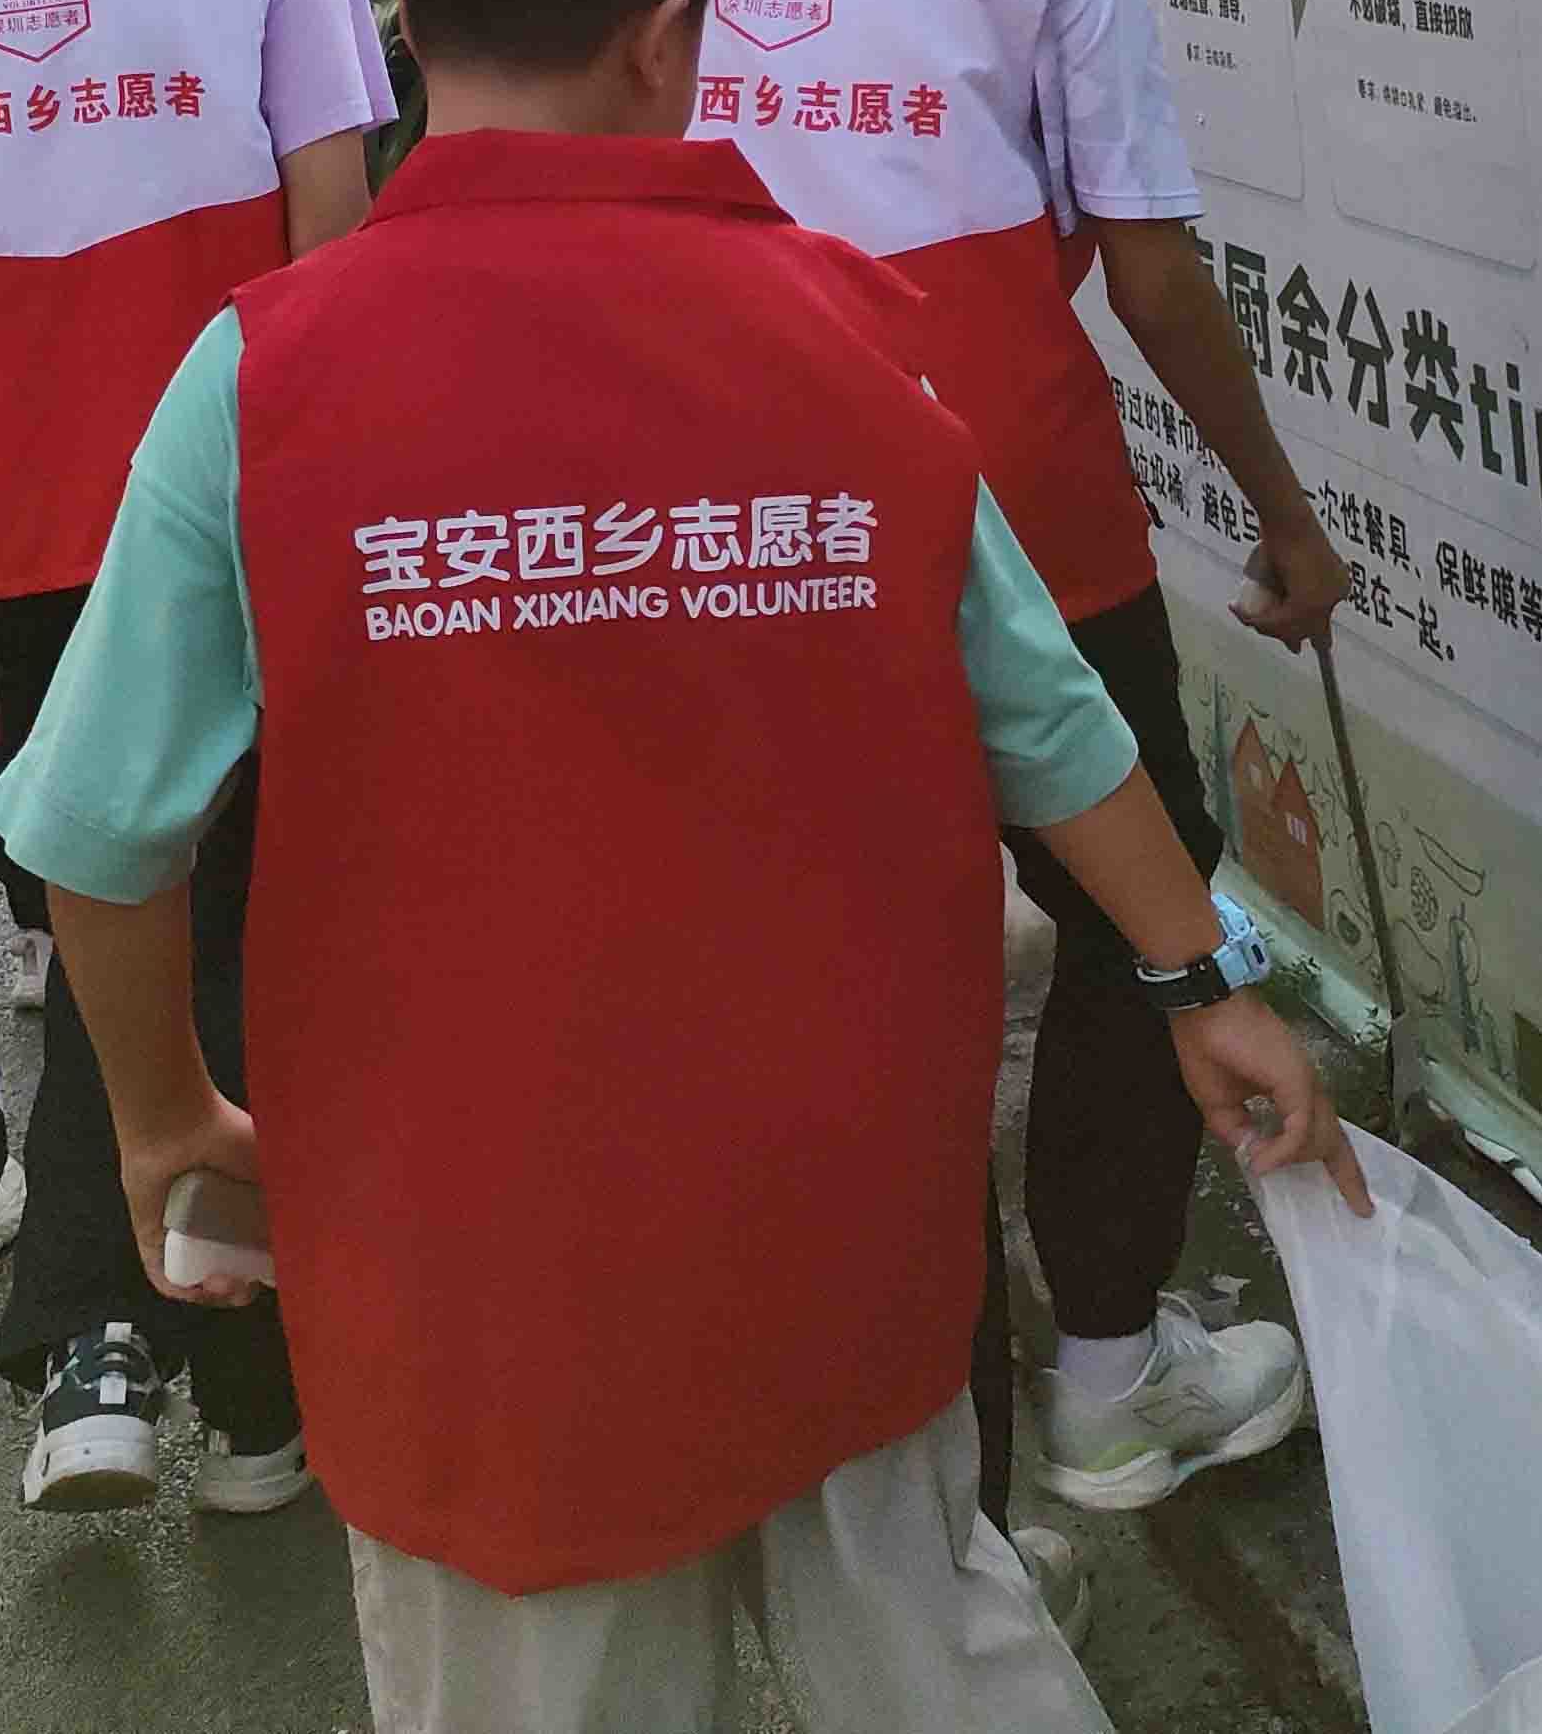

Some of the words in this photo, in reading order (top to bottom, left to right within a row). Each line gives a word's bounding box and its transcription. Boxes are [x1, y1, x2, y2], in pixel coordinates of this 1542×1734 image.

[698, 74, 949, 139] 西乡志愿者
[354, 491, 878, 595] 宝安西乡志愿者
[365, 596, 502, 642] BAOAN
[511, 584, 669, 631] XIXIANG
[679, 574, 877, 620] VOLUNTEER
